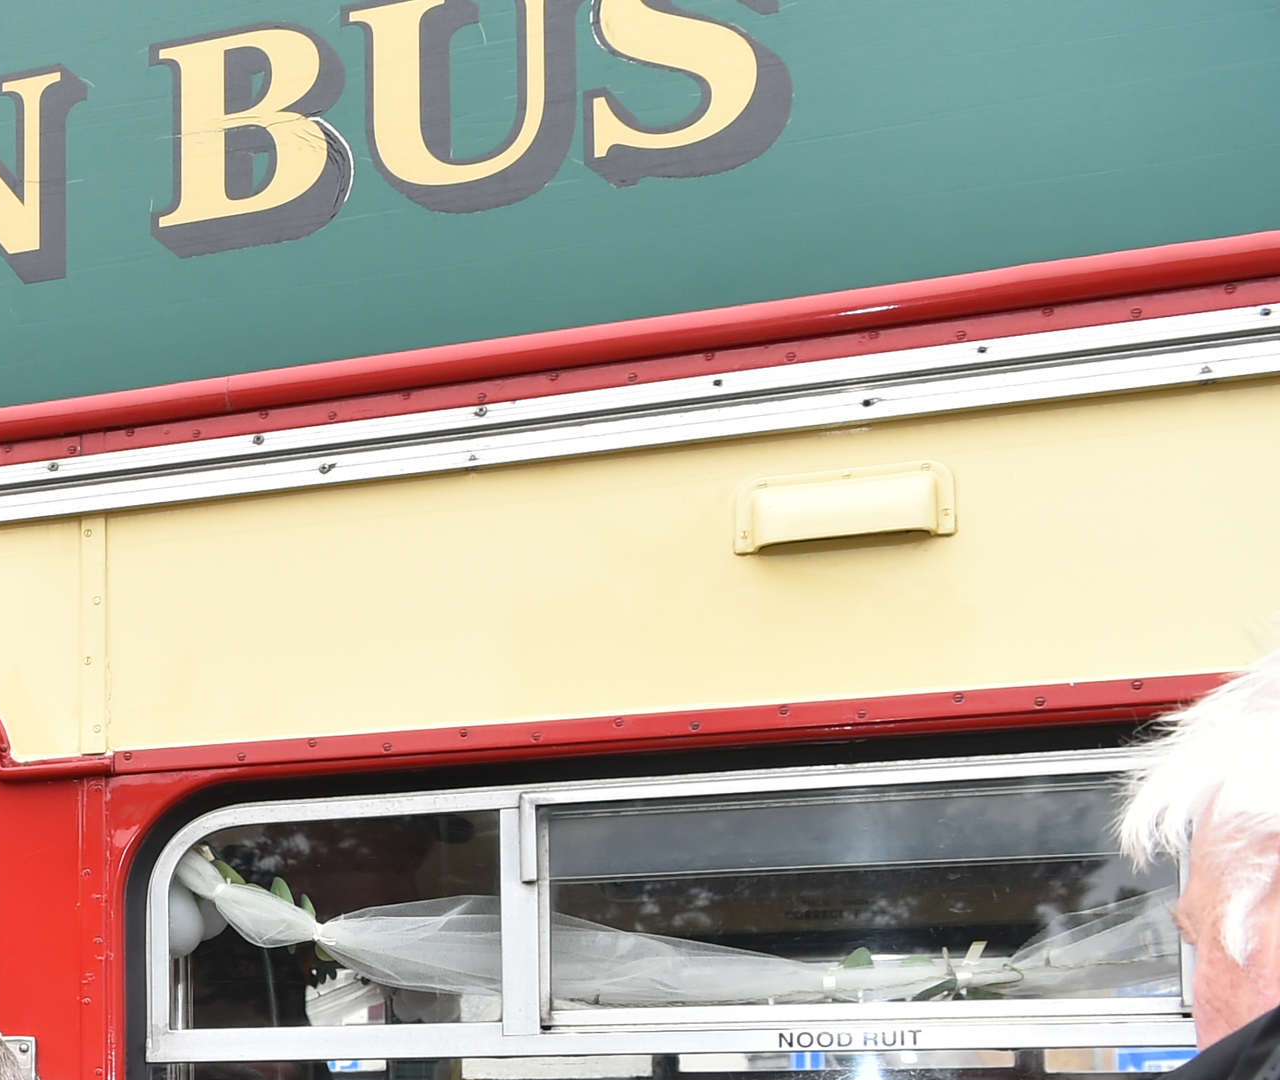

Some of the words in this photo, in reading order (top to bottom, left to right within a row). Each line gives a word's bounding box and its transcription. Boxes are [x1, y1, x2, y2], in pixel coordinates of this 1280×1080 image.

[151, 0, 786, 252] BUS
[778, 1031, 853, 1048] NOOD
[863, 1029, 922, 1047] RUIT
